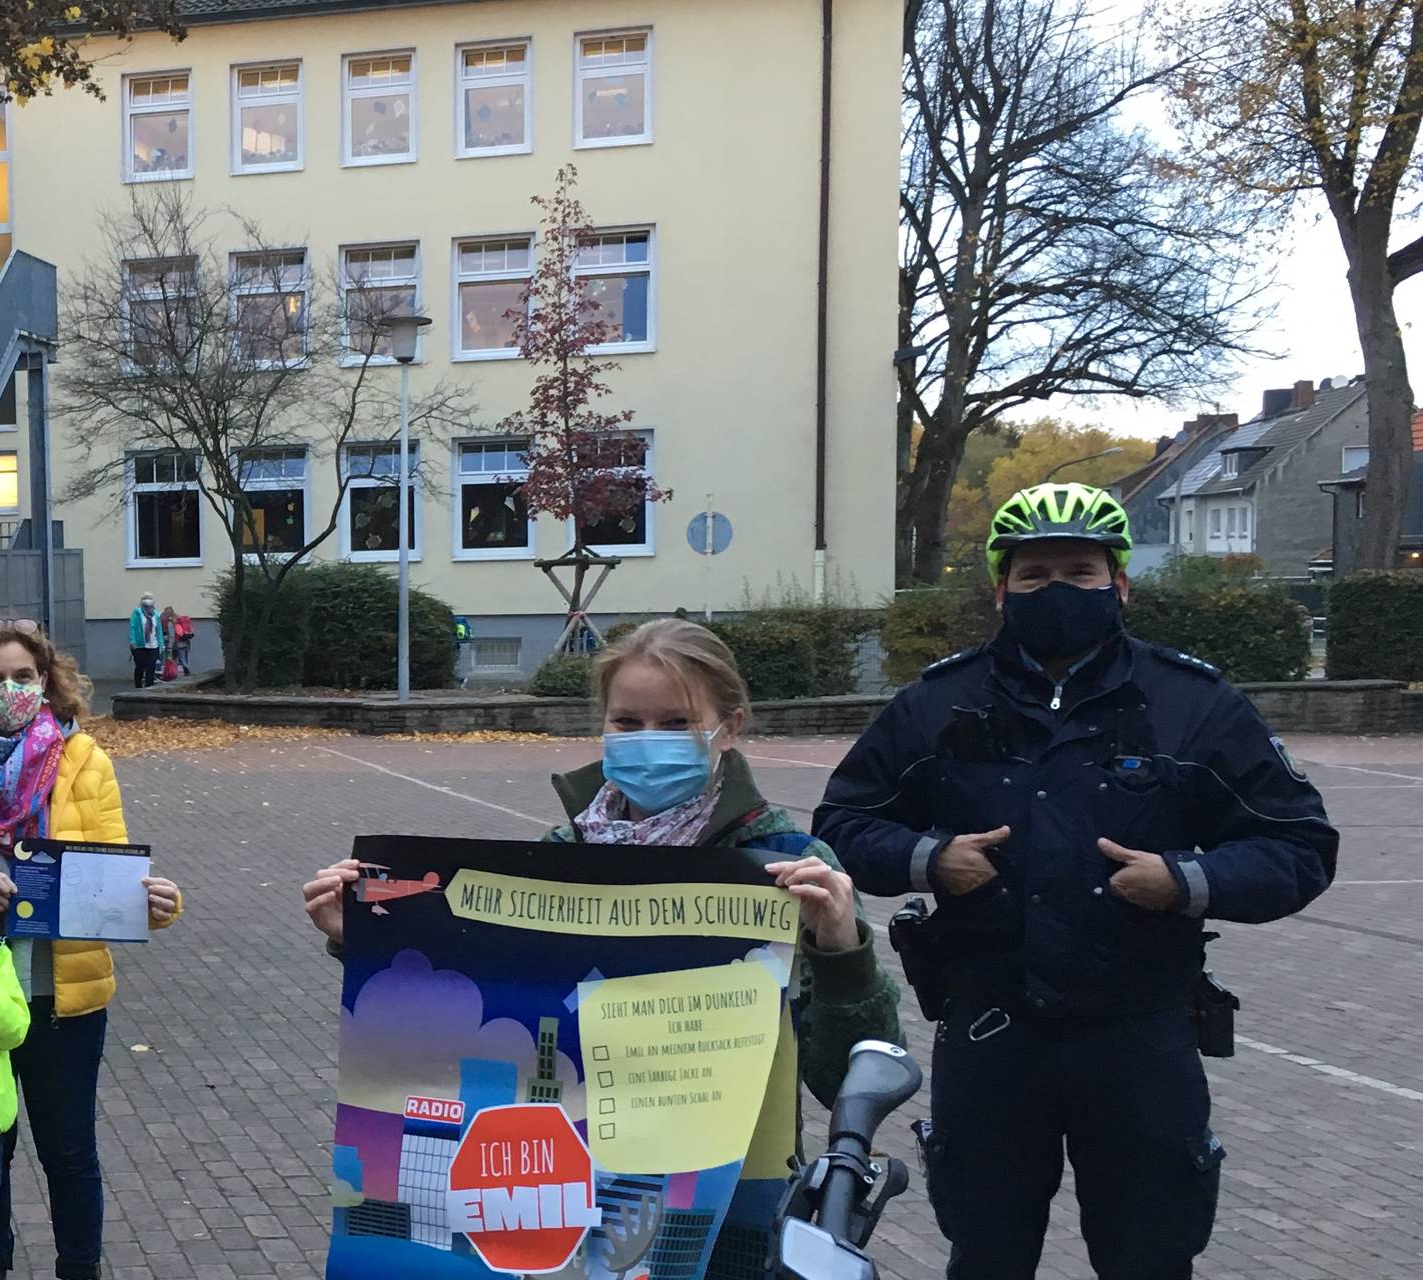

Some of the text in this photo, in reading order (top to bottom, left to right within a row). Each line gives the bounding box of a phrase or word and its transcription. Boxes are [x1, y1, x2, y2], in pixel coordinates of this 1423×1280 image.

[460, 883, 792, 931] MEHR SICHERHEIT AUF DEM SCHULWEG
[600, 988, 758, 1020] SIEHT MAN DICH IM DUNKELN?
[406, 1099, 462, 1119] RADIO
[480, 1137, 555, 1177] ICH BIN
[446, 1182, 603, 1233] EMIL
